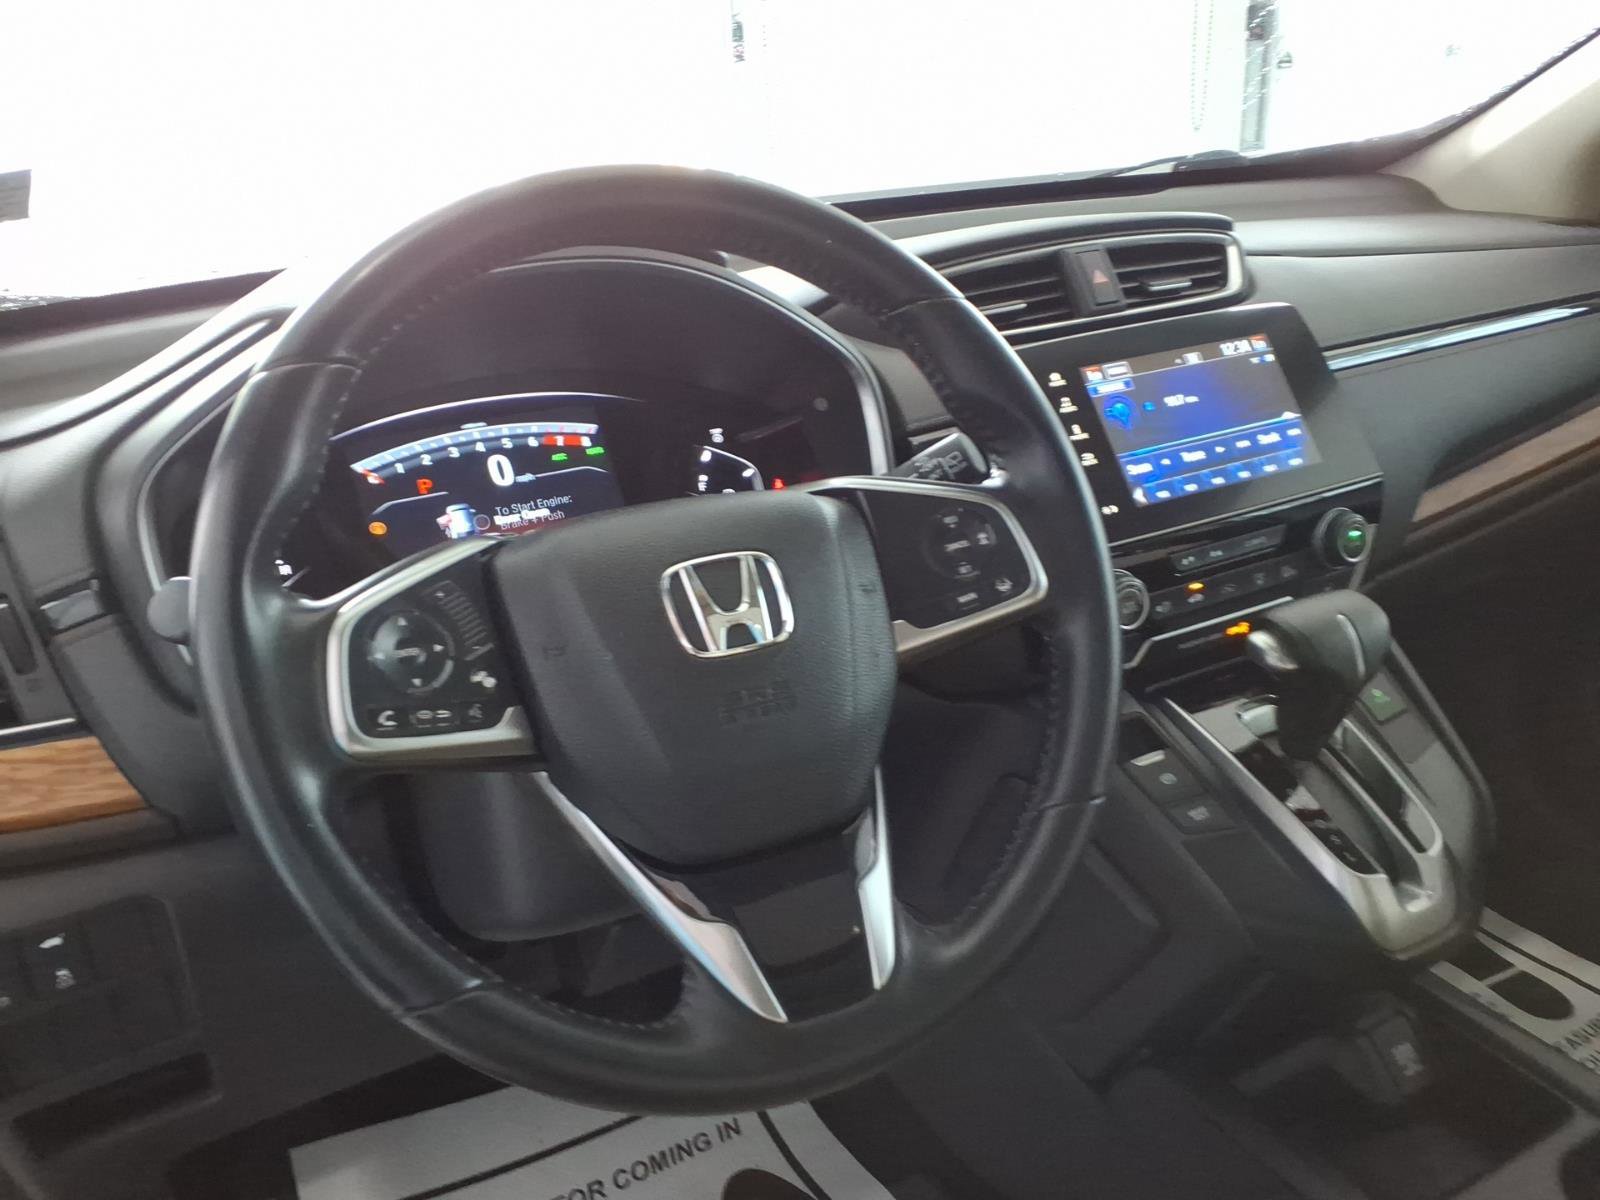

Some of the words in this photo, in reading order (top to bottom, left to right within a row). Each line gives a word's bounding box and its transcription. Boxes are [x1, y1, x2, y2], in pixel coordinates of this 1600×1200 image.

[420, 454, 433, 465] 2
[447, 446, 460, 458] 3
[475, 441, 486, 452] 4
[501, 437, 513, 448] 5
[527, 436, 539, 447] 6
[487, 454, 515, 487] 0
[416, 477, 433, 495] P
[495, 505, 509, 517] To
[511, 500, 535, 514] Start
[537, 495, 573, 509] Engine:
[612, 1132, 714, 1191] COMING
[715, 1117, 742, 1143] IN
